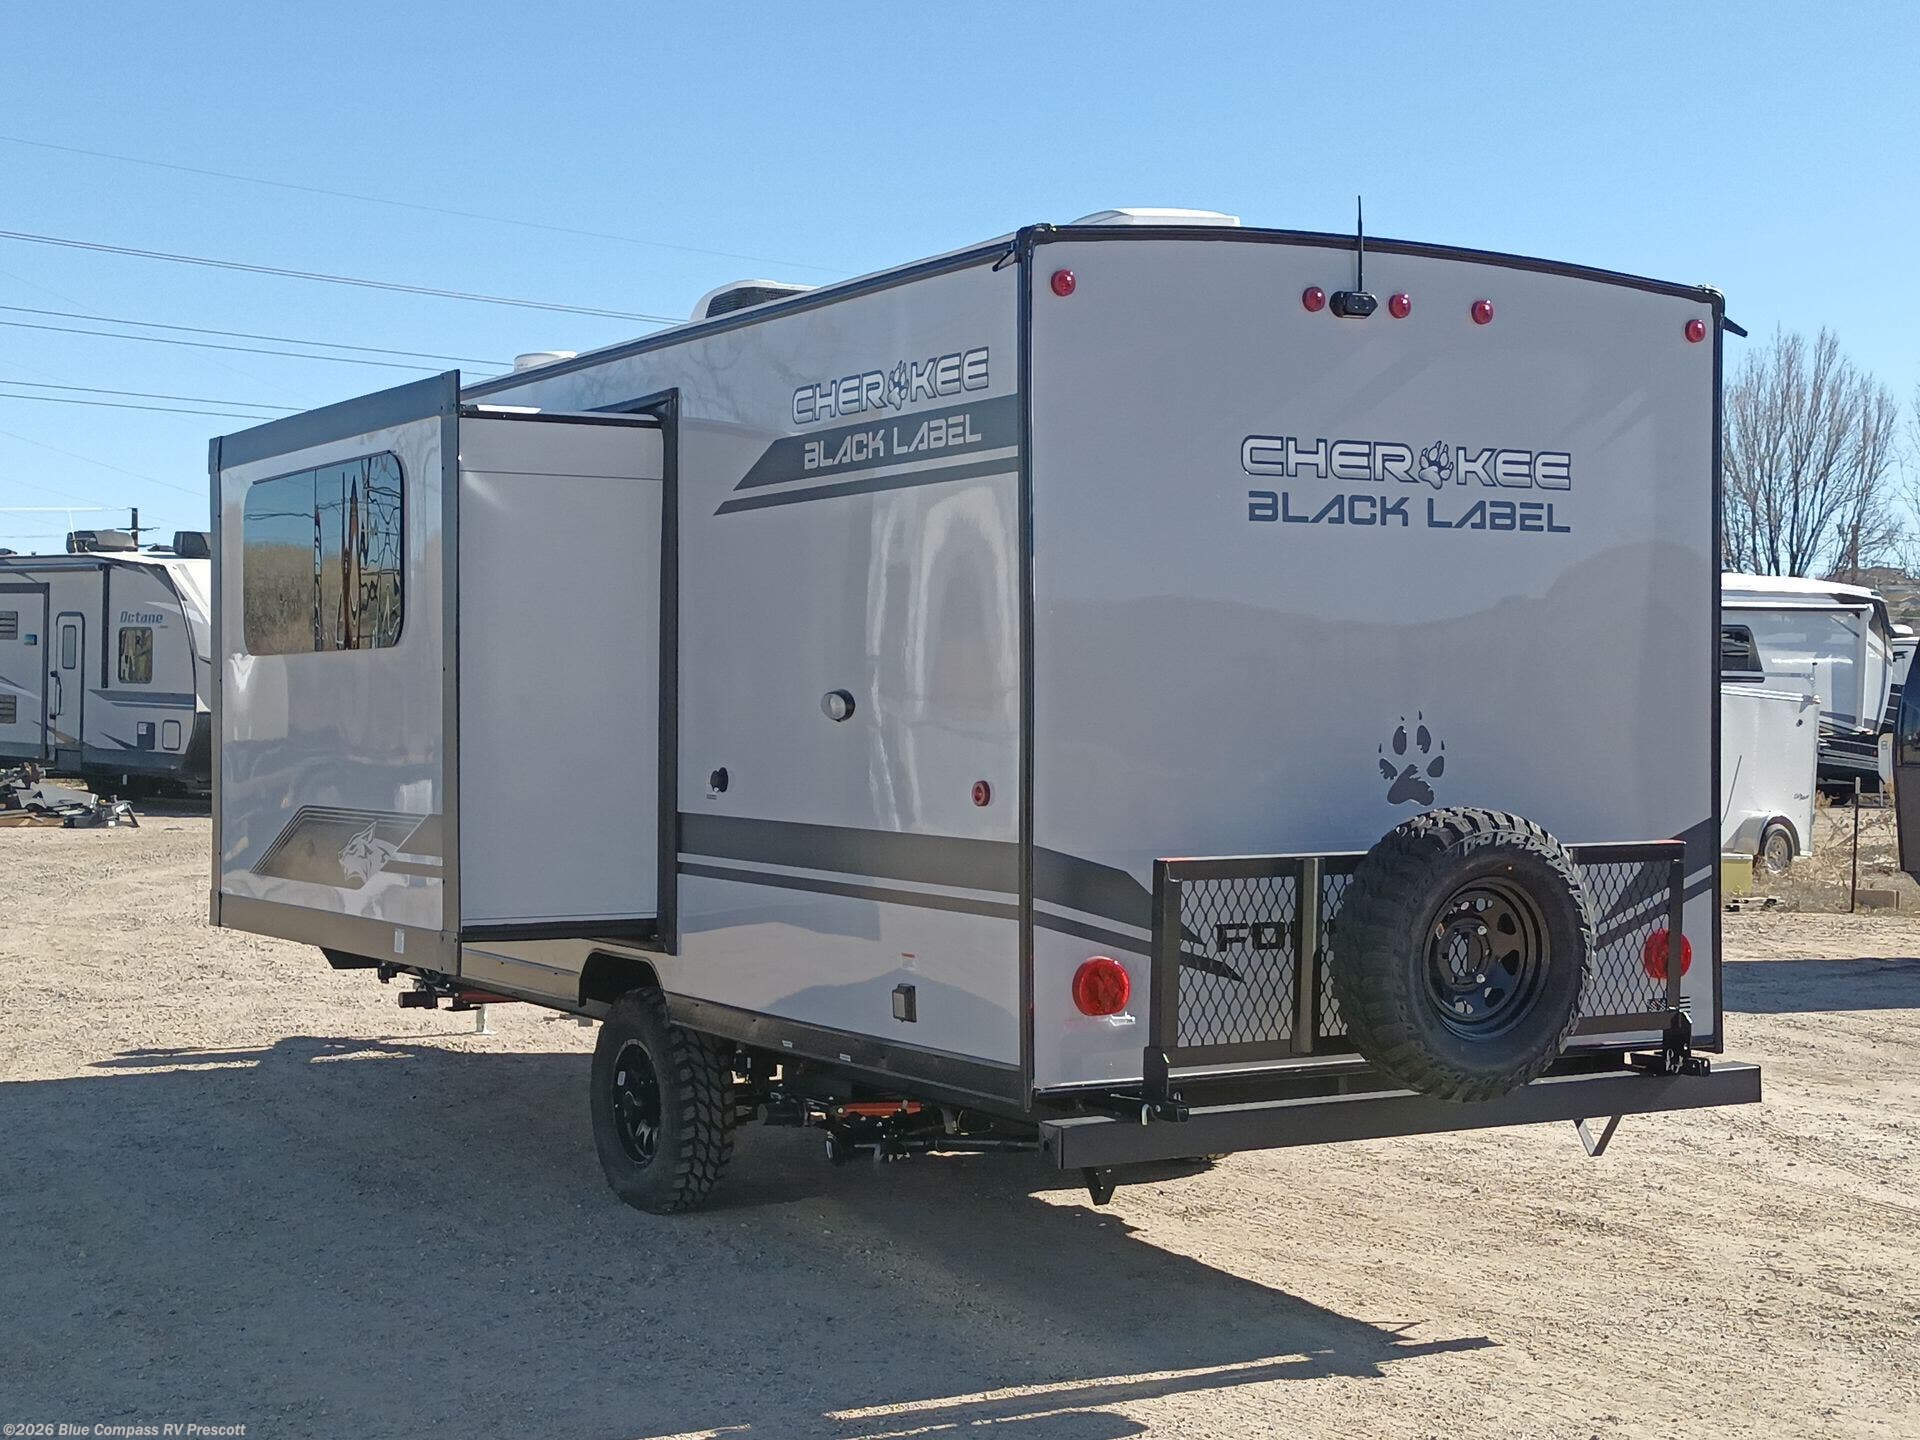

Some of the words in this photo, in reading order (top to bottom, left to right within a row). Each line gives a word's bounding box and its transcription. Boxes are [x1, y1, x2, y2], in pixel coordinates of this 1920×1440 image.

[804, 429, 885, 470] BLACK
[893, 414, 982, 455] LABEL
[1248, 490, 1410, 527] BLACK
[1427, 497, 1571, 533] LABEL
[120, 611, 163, 624] Octane
